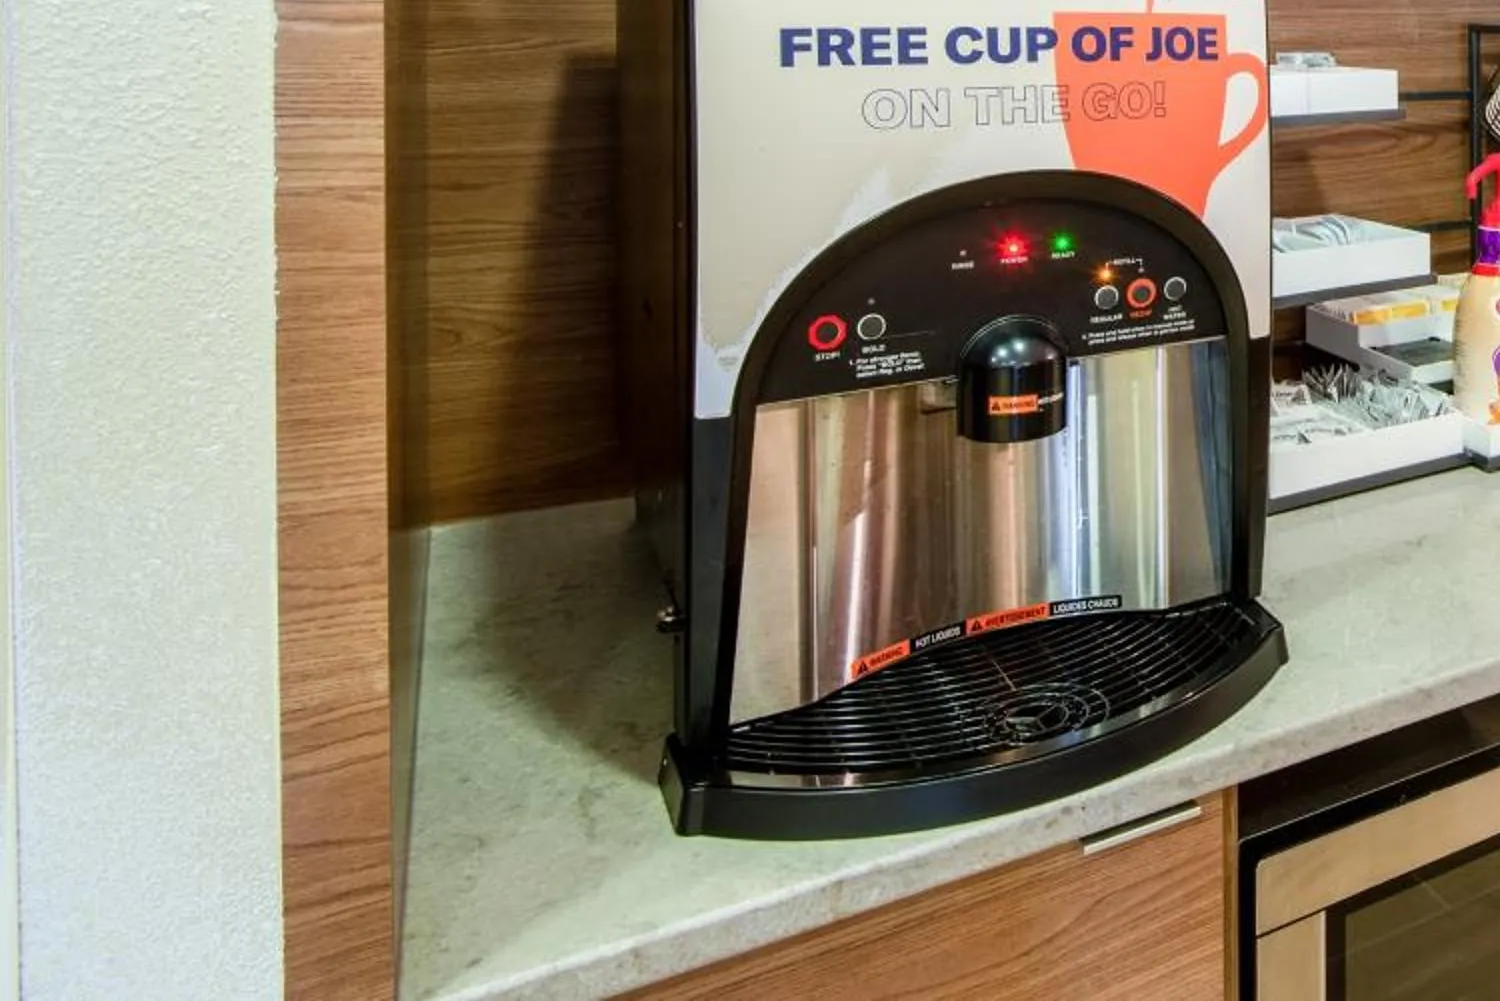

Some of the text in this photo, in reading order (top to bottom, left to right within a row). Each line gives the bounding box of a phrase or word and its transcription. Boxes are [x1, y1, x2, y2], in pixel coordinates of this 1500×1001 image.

[779, 26, 1219, 67] FREE CUP OF JOE
[861, 80, 1167, 130] ON THE GO!
